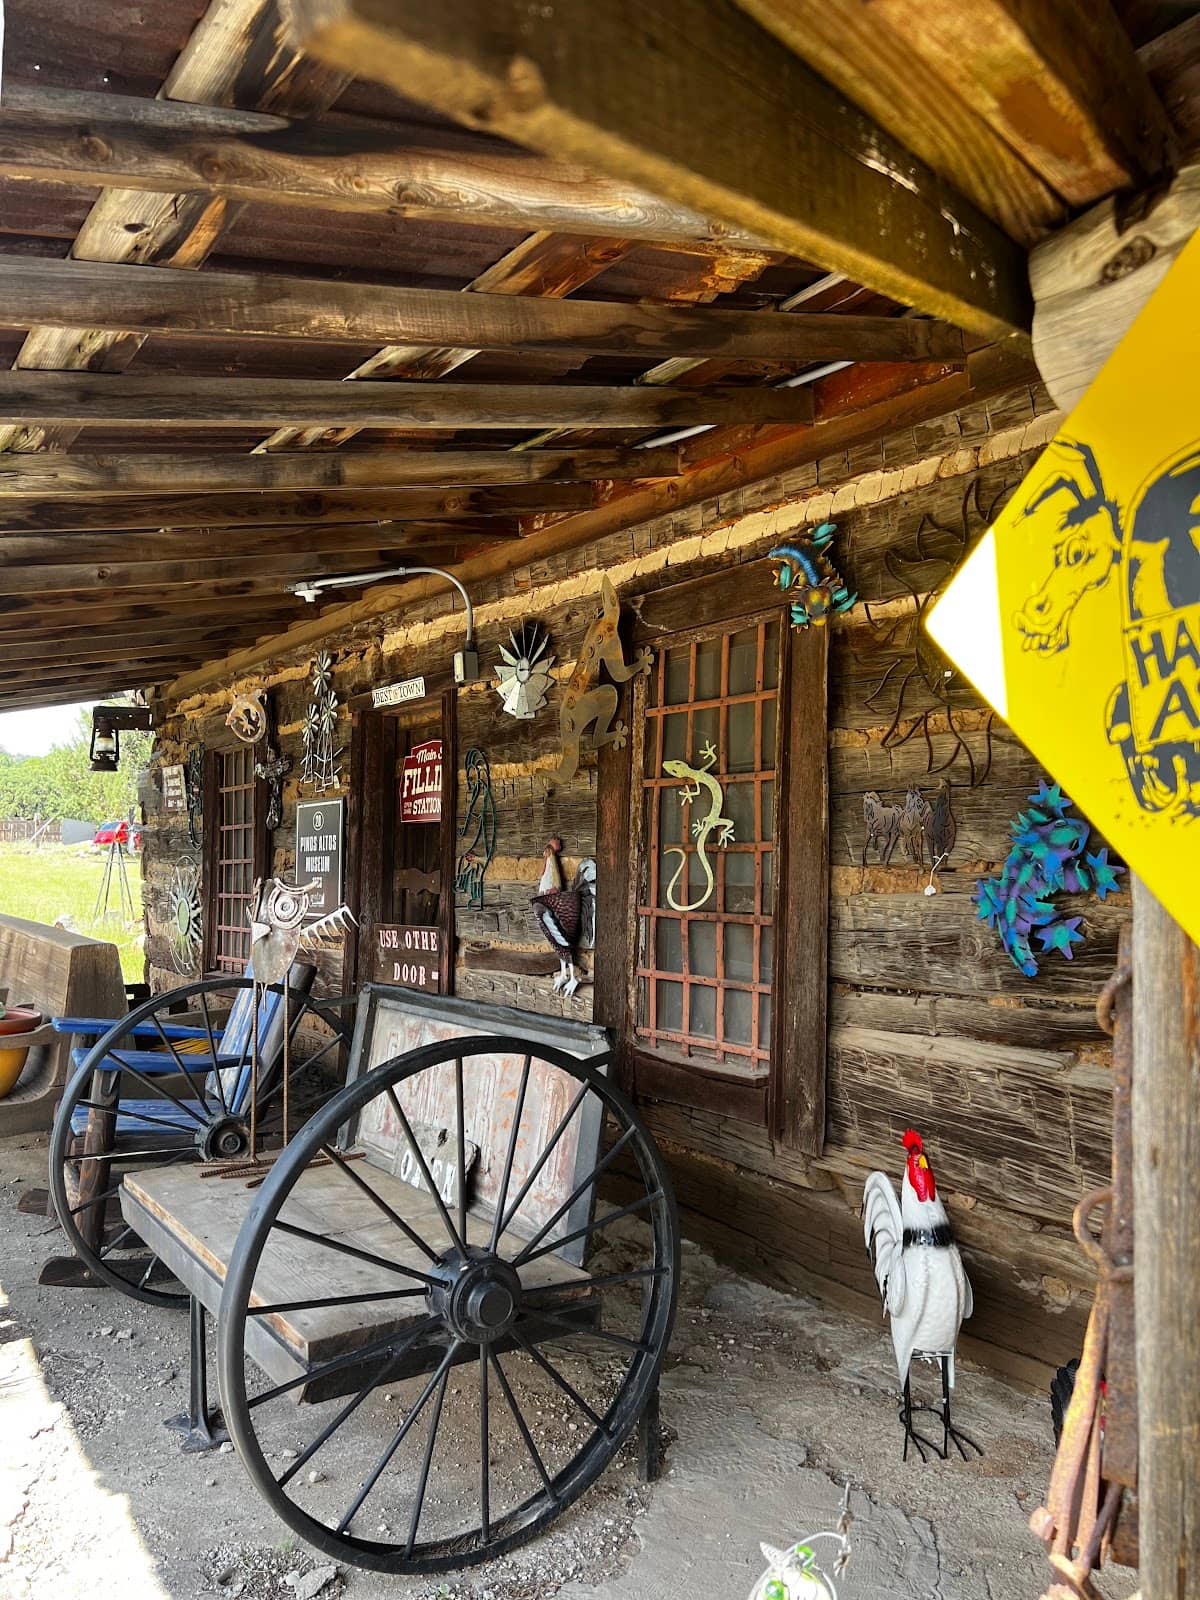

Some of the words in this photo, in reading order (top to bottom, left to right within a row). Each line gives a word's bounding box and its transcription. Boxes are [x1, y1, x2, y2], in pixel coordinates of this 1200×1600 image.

[375, 690, 392, 704] BEST
[1149, 677, 1200, 741] A
[416, 749, 437, 764] Main
[413, 797, 442, 815] STATION
[300, 836, 318, 852] PINOS
[319, 835, 336, 851] ALTOS
[305, 856, 330, 872] MUSEUM
[380, 930, 399, 949] USE
[393, 962, 426, 986] DOOR
